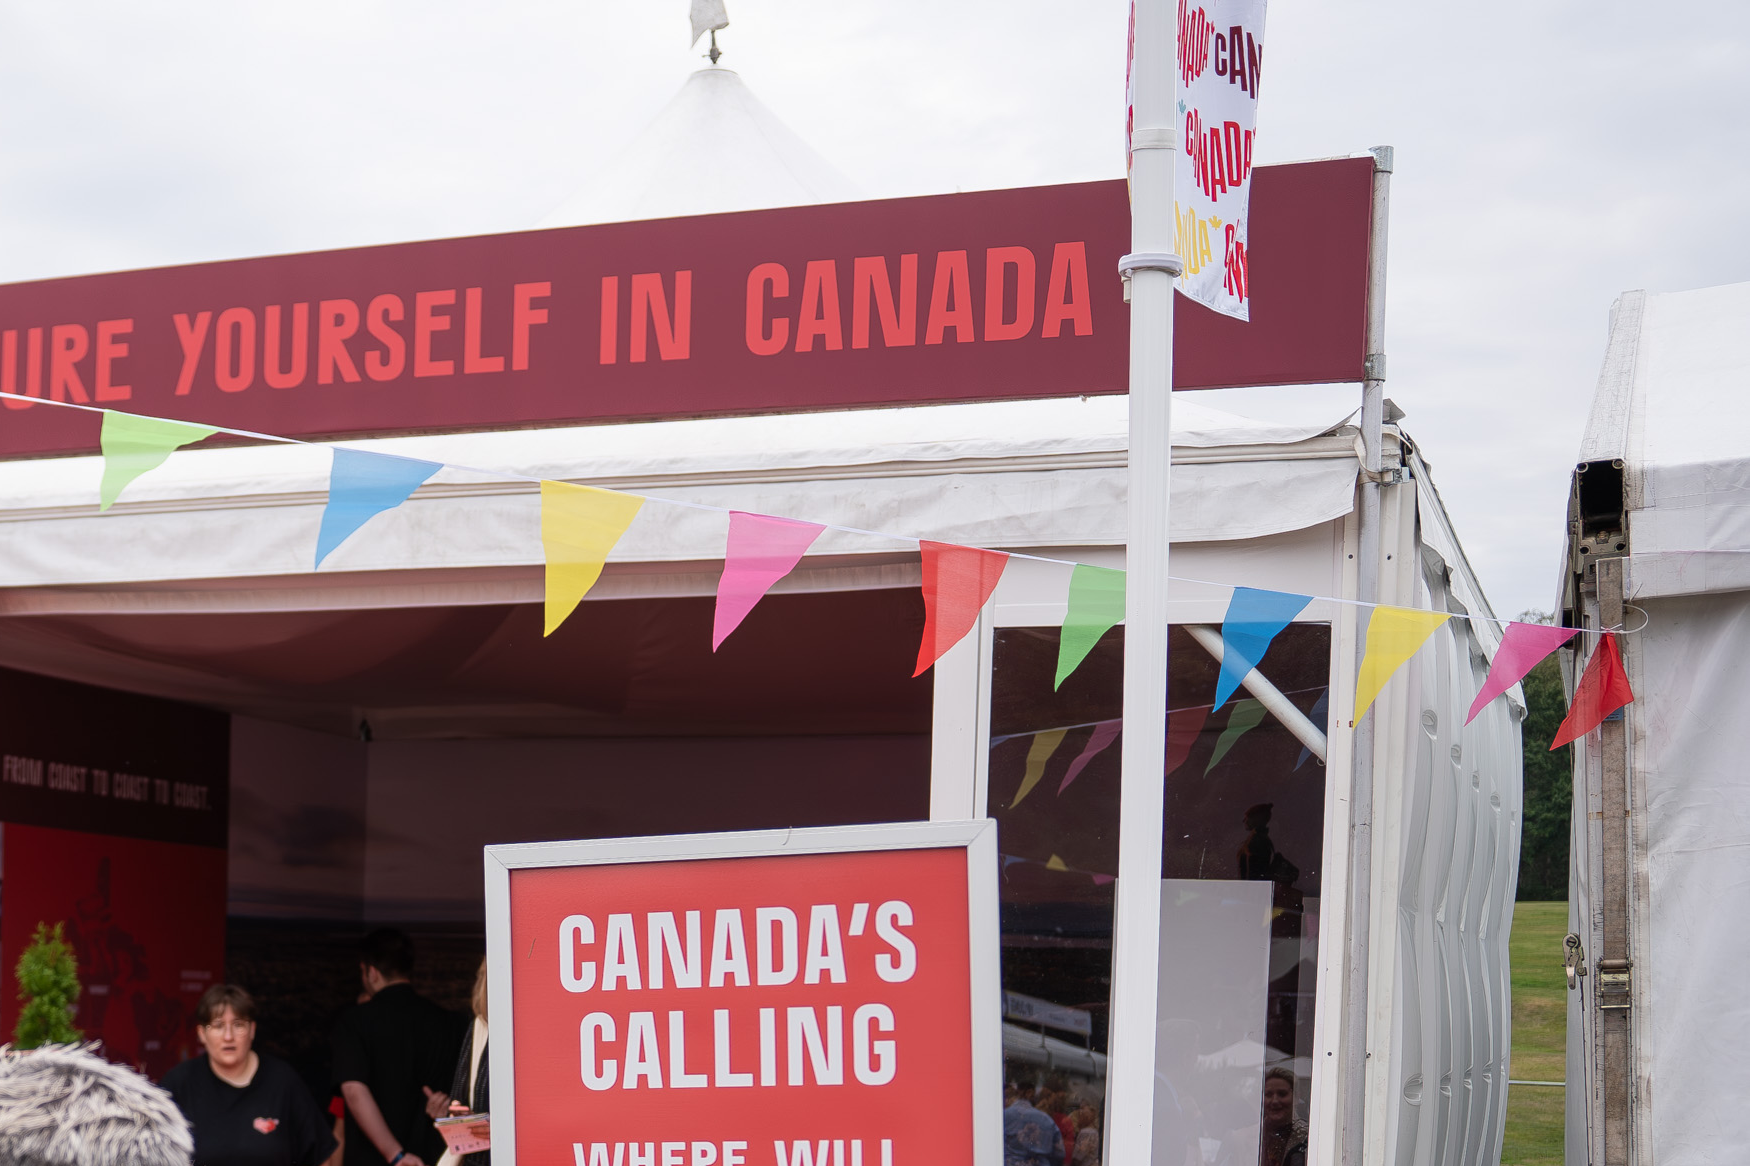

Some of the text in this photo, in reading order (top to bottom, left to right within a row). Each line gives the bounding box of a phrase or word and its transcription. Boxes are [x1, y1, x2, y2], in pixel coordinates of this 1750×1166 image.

[1185, 107, 1252, 202] CANADA
[174, 281, 552, 397] YOURSELF
[599, 270, 692, 365] IN
[745, 241, 1093, 356] CANADA
[558, 900, 917, 993] CANADA'S
[579, 1003, 897, 1091] CALLING
